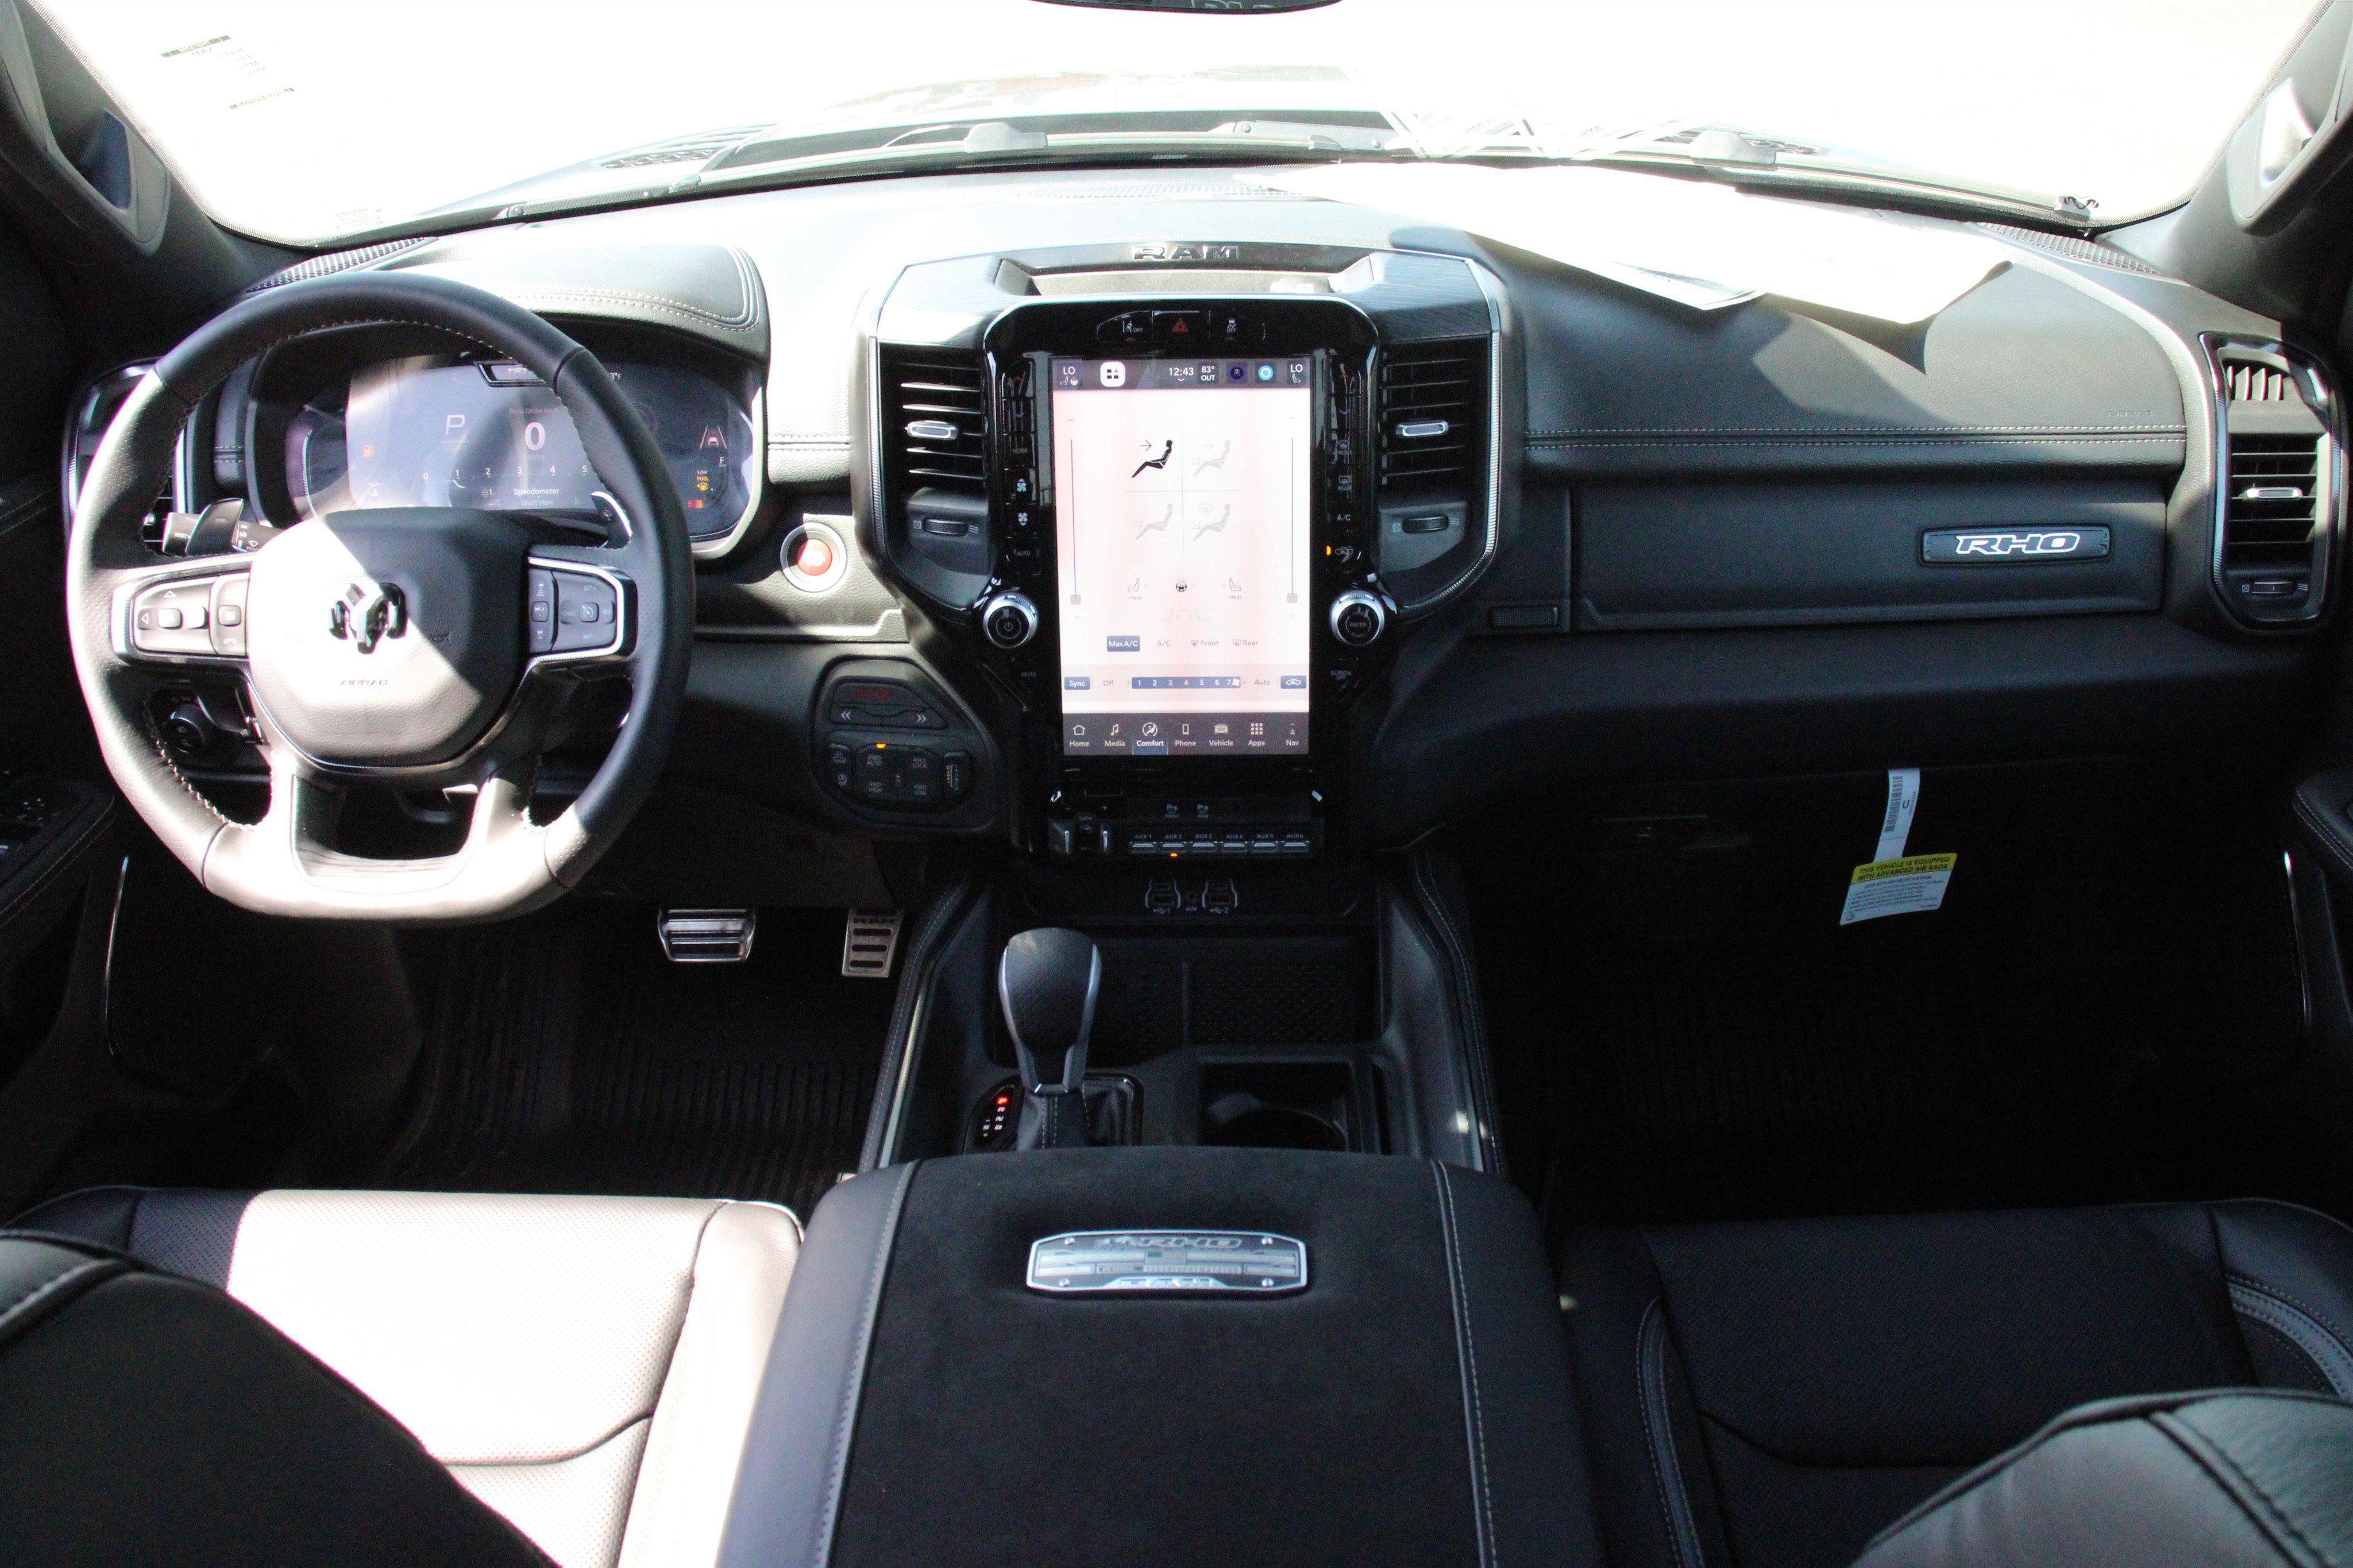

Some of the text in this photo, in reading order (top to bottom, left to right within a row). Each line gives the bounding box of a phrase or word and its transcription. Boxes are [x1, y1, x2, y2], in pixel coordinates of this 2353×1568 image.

[1132, 245, 1239, 259] RAM
[1063, 366, 1075, 375] LO
[1169, 367, 1194, 376] 12:43
[1290, 364, 1303, 373] LO
[446, 415, 465, 435] P
[525, 422, 546, 451] 0
[485, 468, 491, 476] 2
[550, 465, 555, 473] 4
[514, 488, 560, 497] Speedometer
[1955, 532, 2081, 555] RHO
[1876, 861, 1904, 870] VEHICLE
[1914, 856, 1950, 865] EQUIPPED
[1858, 873, 1875, 881] WITH
[1875, 867, 1914, 878] ADVANCED
